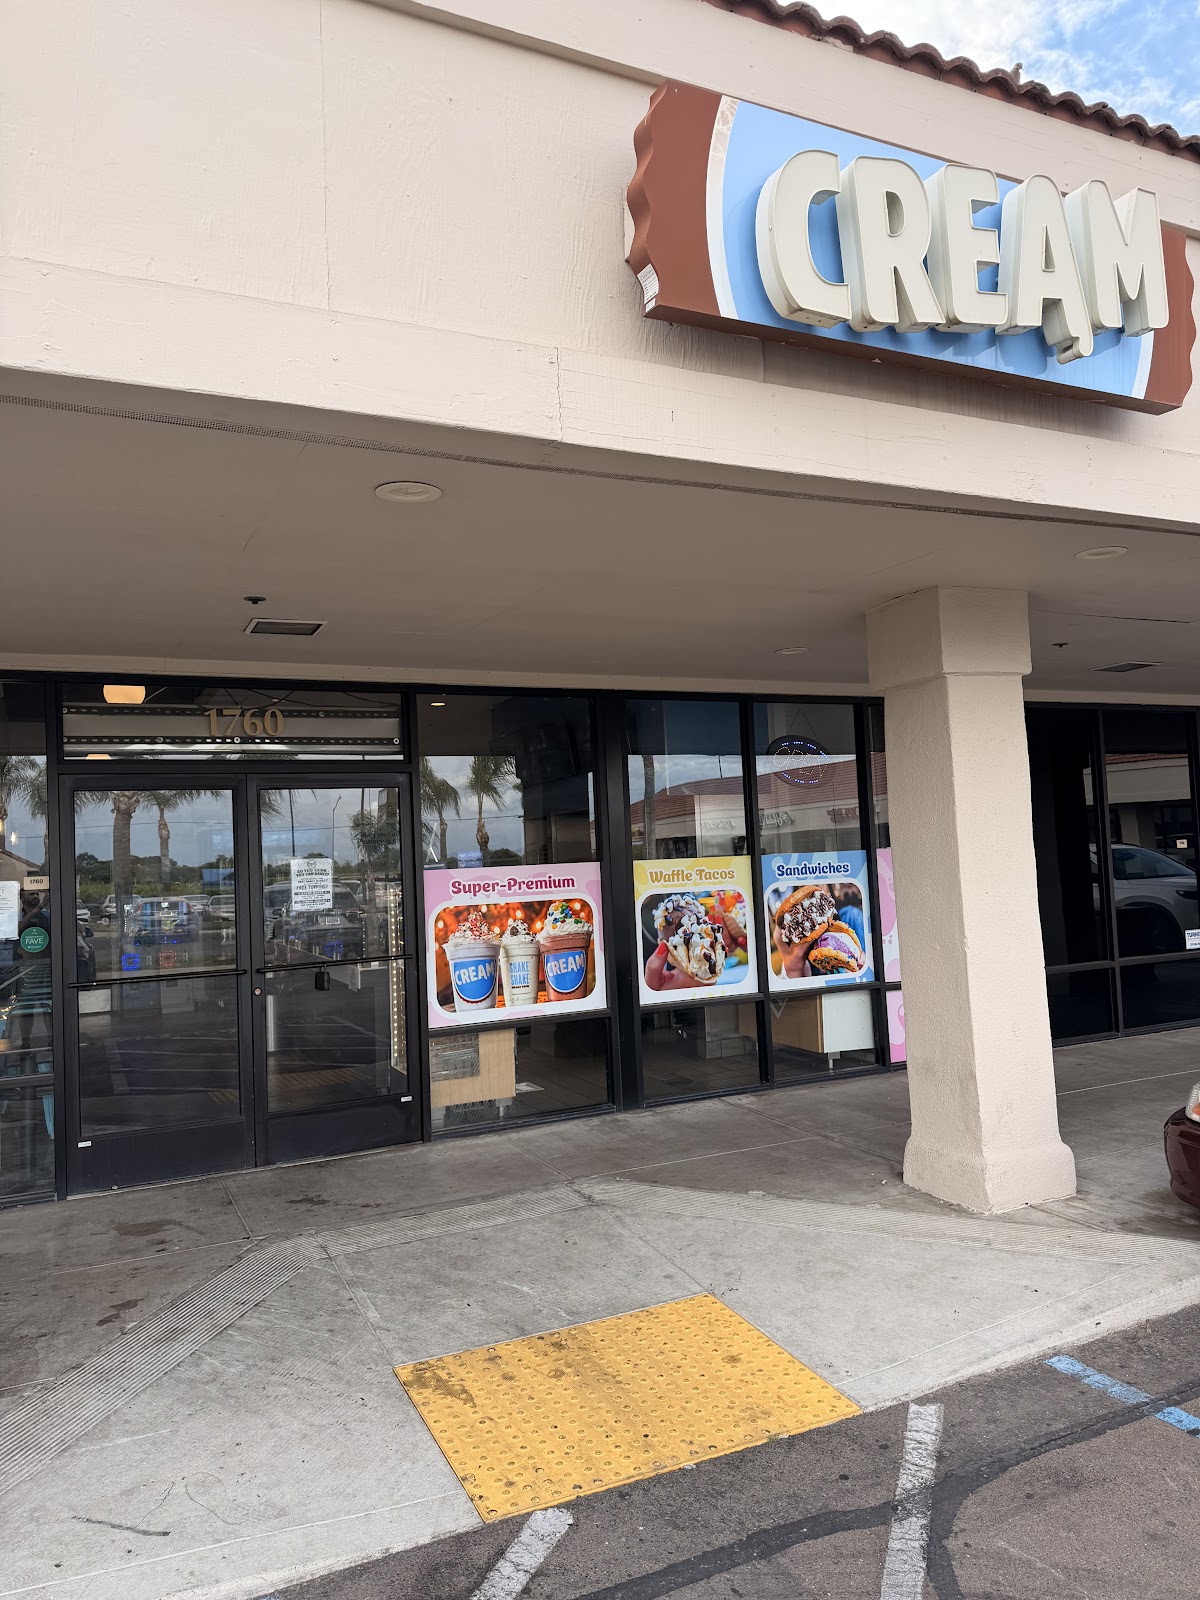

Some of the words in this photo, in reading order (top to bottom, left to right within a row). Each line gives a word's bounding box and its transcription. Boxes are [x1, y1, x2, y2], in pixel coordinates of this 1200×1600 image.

[755, 149, 1169, 364] CREAM
[204, 708, 284, 737] 1760
[649, 868, 693, 884] Waffle
[696, 868, 736, 882] Tacos
[776, 862, 850, 877] Sandwiches
[451, 875, 576, 897] Super-Premium
[454, 961, 495, 986] CREAM
[509, 961, 530, 974] SHAKE
[547, 953, 586, 977] CREAM
[511, 973, 530, 986] SHAKE
